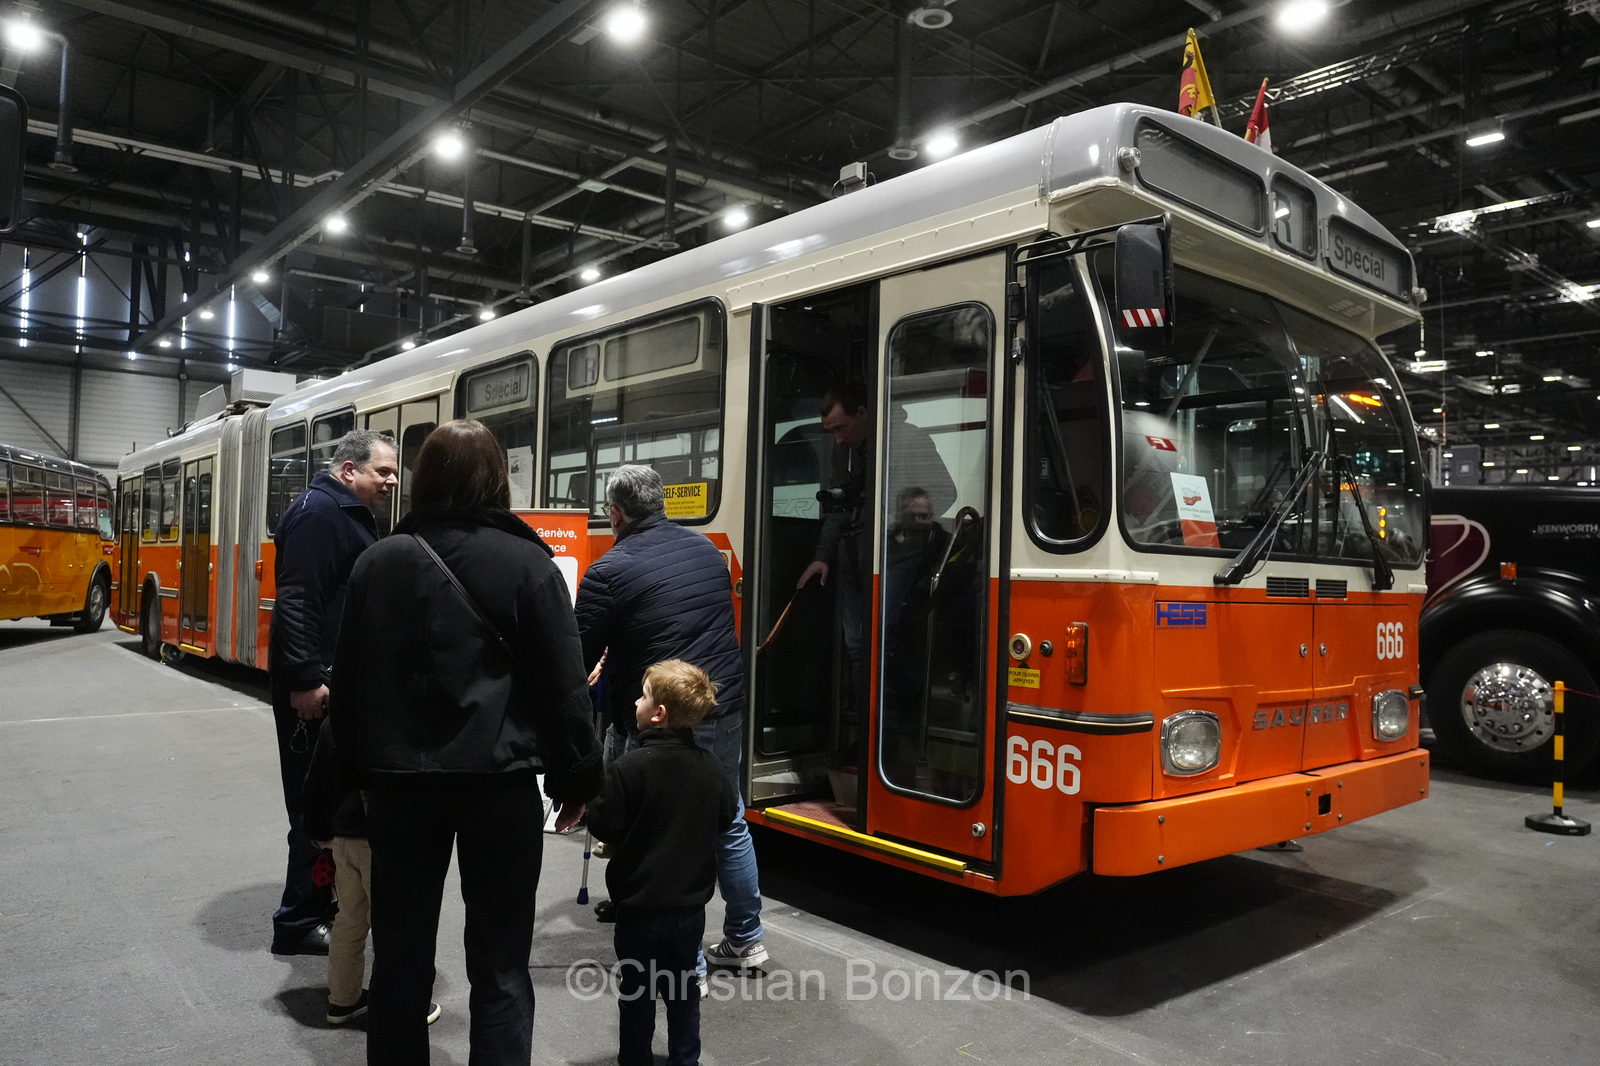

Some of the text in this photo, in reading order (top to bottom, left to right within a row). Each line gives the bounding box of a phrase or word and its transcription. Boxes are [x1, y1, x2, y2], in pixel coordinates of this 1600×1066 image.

[1334, 234, 1385, 281] Spécial
[485, 376, 522, 402] Spécial
[663, 486, 700, 498] SELF-SERVICE
[536, 527, 577, 540] Genève,
[1537, 524, 1599, 534] KENWORTH
[1157, 603, 1207, 626] HESS
[1376, 621, 1404, 660] 666
[1252, 702, 1349, 731] SAURER
[1006, 735, 1082, 796] 666
[748, 944, 764, 955] adida
